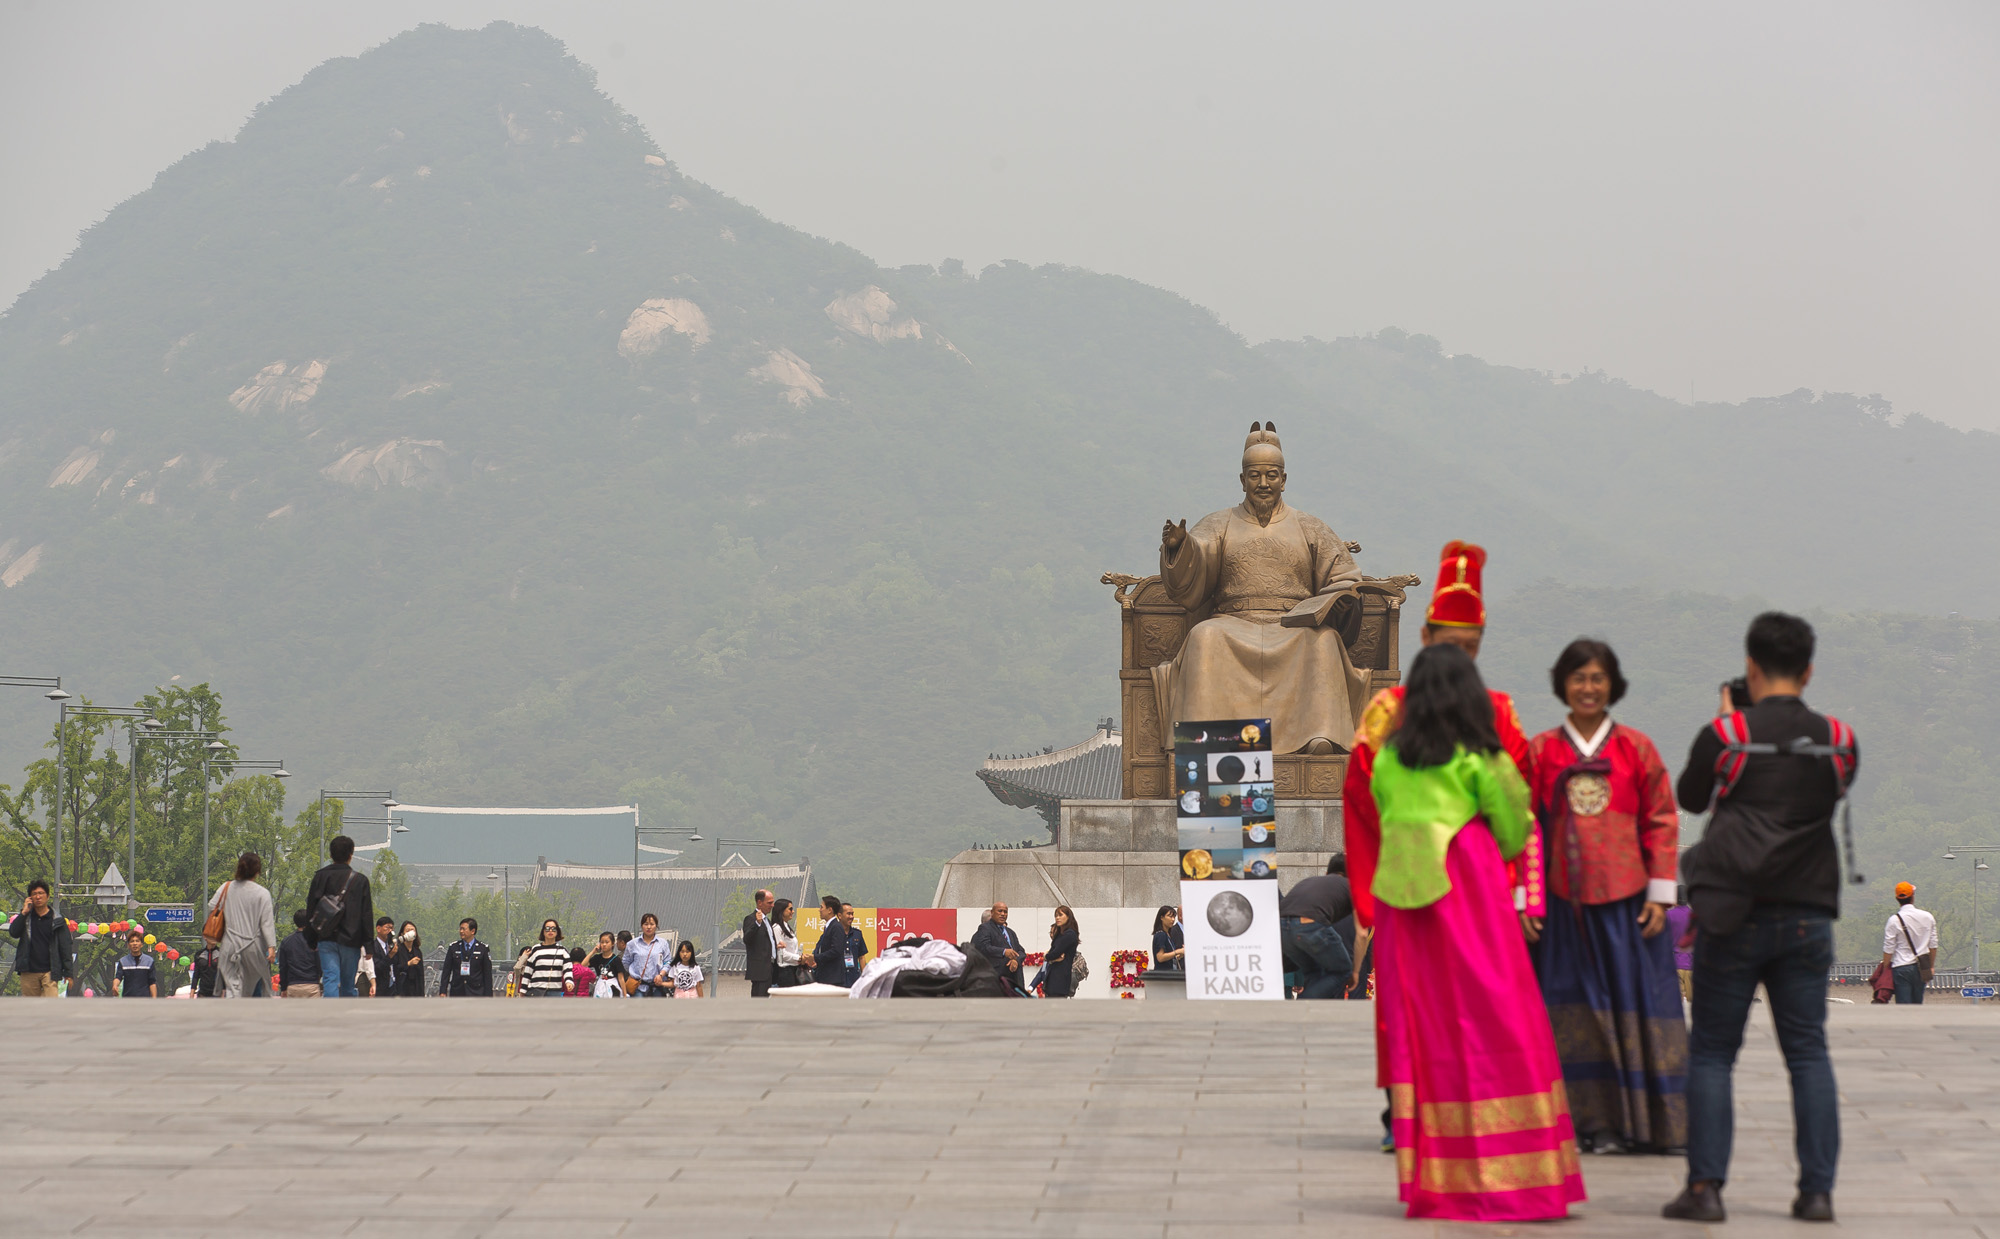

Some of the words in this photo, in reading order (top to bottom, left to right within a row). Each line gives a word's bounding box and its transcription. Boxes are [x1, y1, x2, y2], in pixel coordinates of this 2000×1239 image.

[865, 917, 890, 931] 되신
[894, 917, 906, 930] 지
[1205, 975, 1264, 995] KANG
